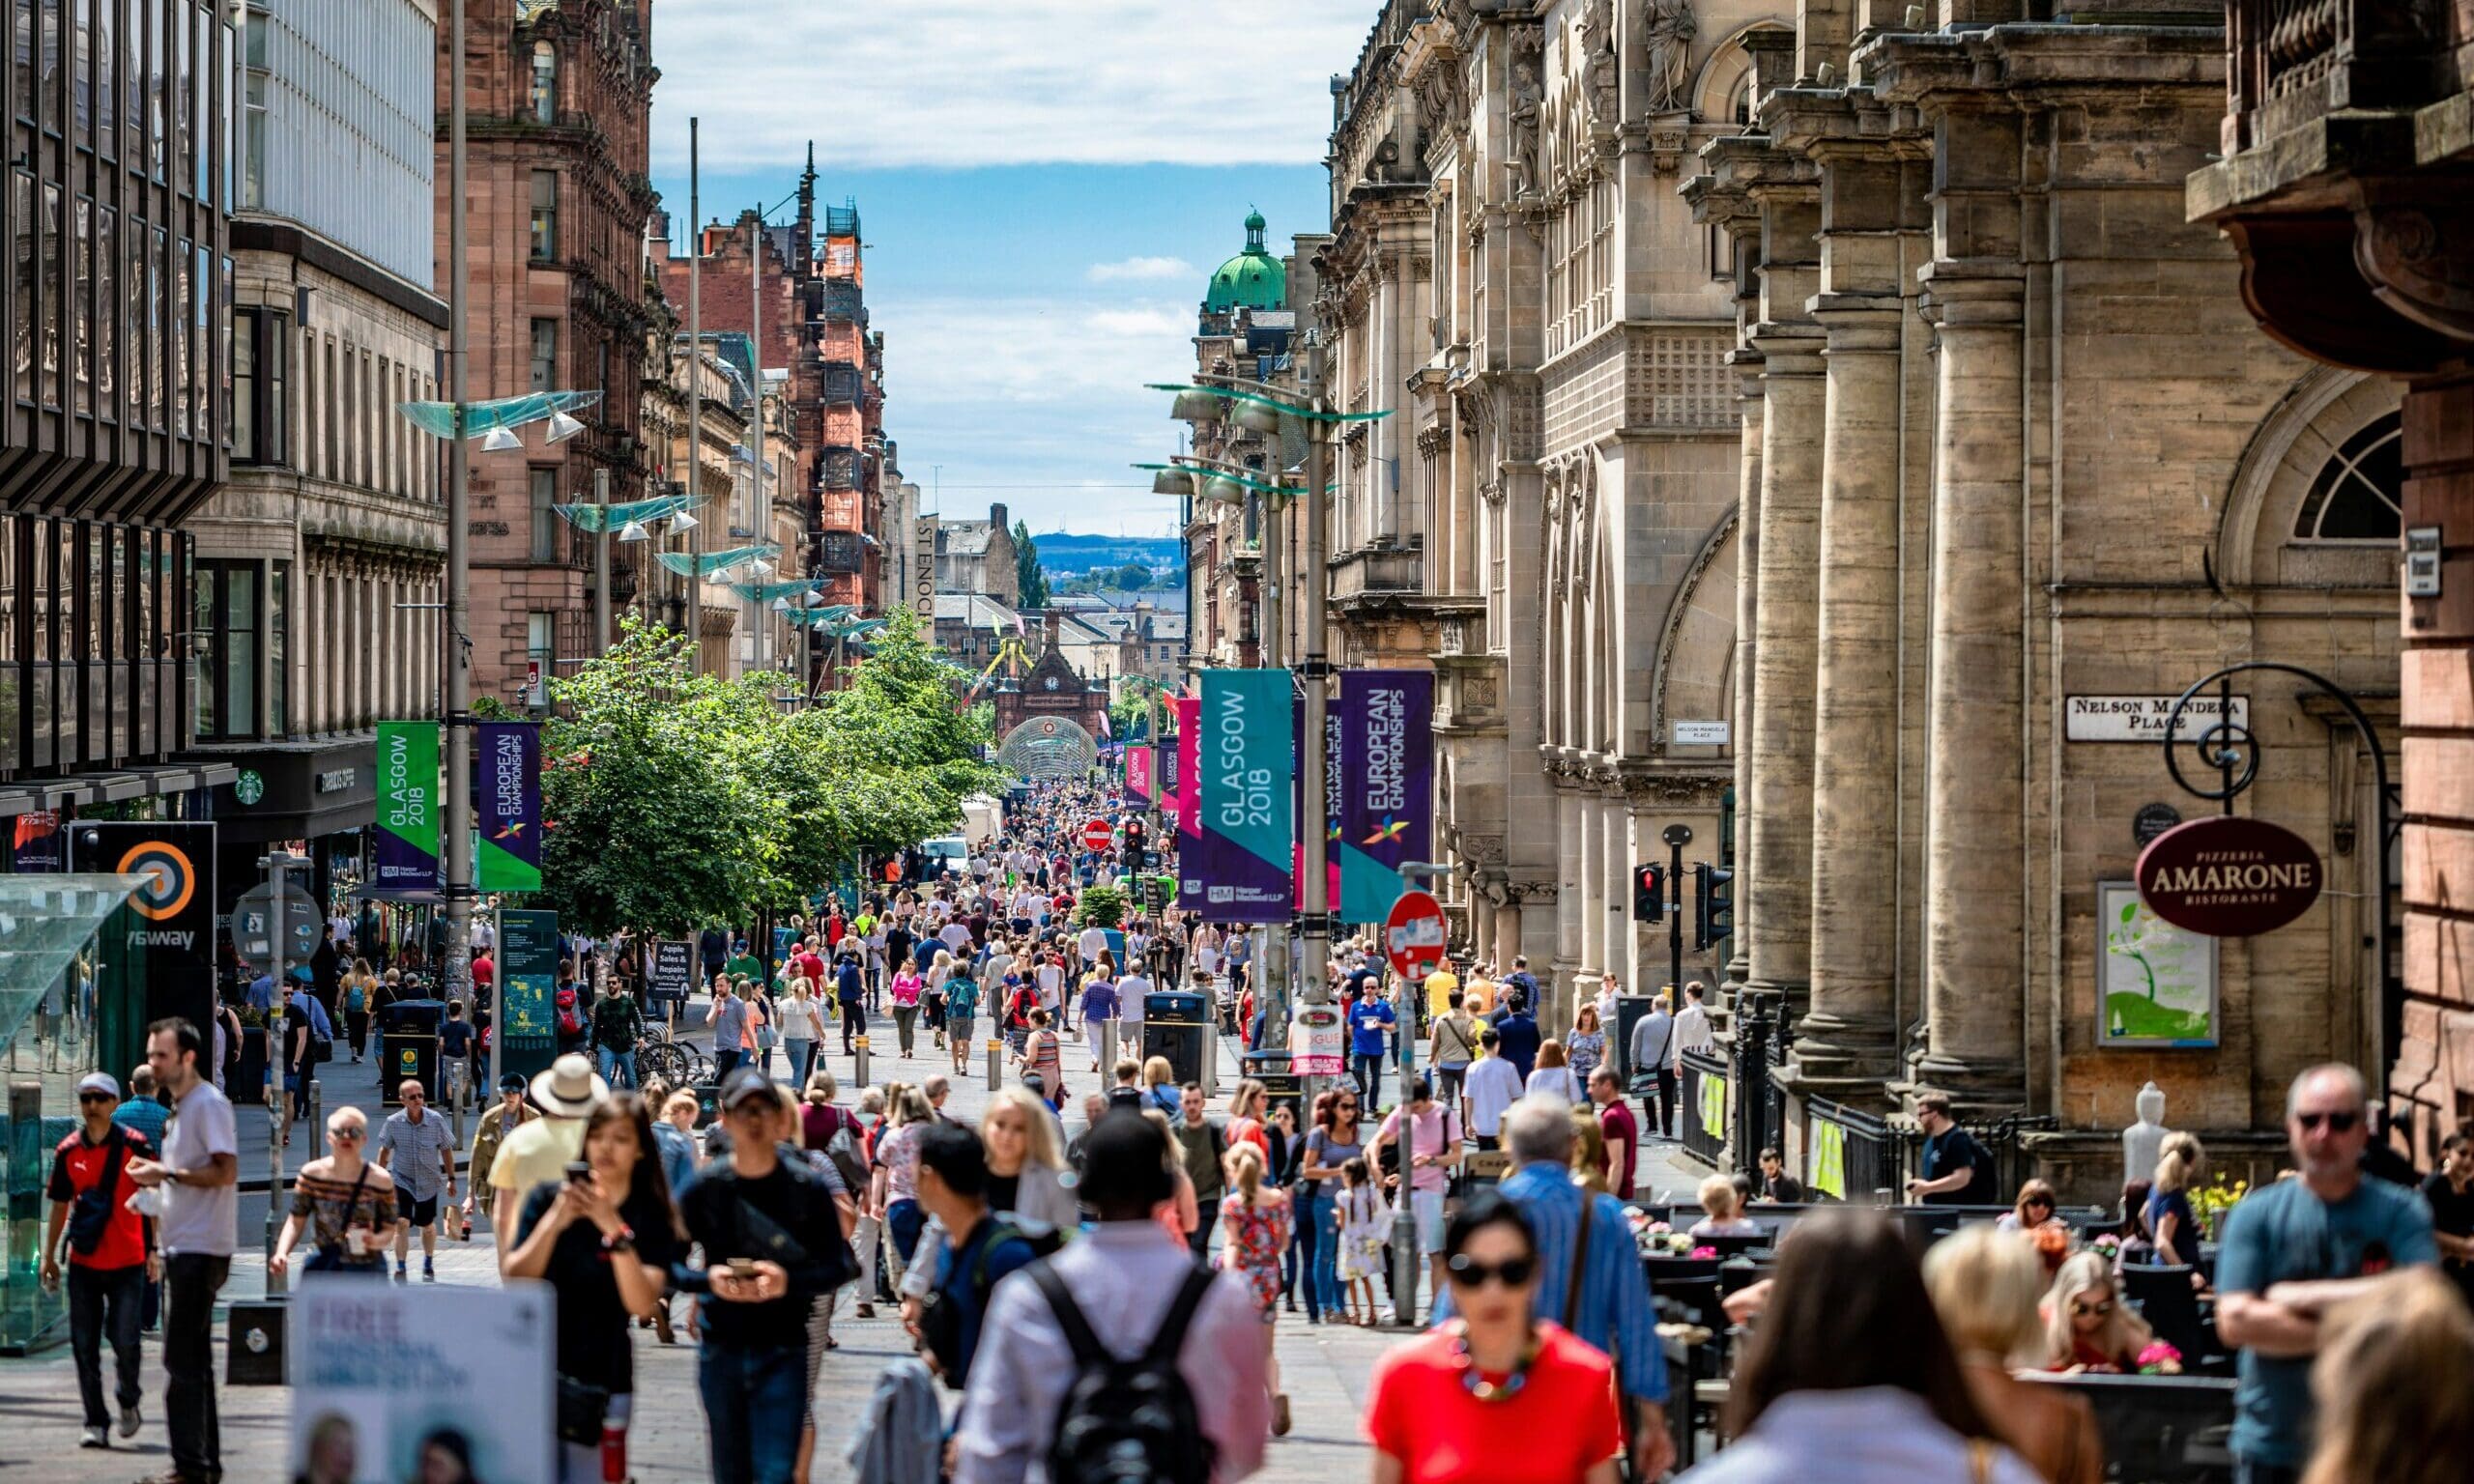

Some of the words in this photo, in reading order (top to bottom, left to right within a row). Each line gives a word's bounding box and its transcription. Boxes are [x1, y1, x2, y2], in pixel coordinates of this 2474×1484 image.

[917, 527, 933, 548] ST
[2074, 699, 2143, 713] NELSON
[2152, 699, 2240, 714] MNDEA
[1221, 690, 1246, 827] GLASGOW
[1366, 689, 1390, 811] EUROPEAN
[1389, 689, 1405, 811] CHAMPIONSHIPS
[389, 734, 408, 826] GLASGOW
[497, 734, 512, 816] EUROPEAN
[512, 734, 523, 815] CHAMPIONSHIPS
[409, 786, 425, 826] 2018
[1248, 768, 1272, 826] 2018
[2196, 851, 2265, 863] PIZZERIA
[2151, 863, 2313, 894] AMARONE
[1210, 888, 1233, 900] HM
[1269, 893, 1285, 902] LLP
[2184, 893, 2278, 906] RISTORANTE
[659, 955, 679, 963] Sales
[662, 945, 685, 955] Apple
[659, 965, 687, 974] Repairs
